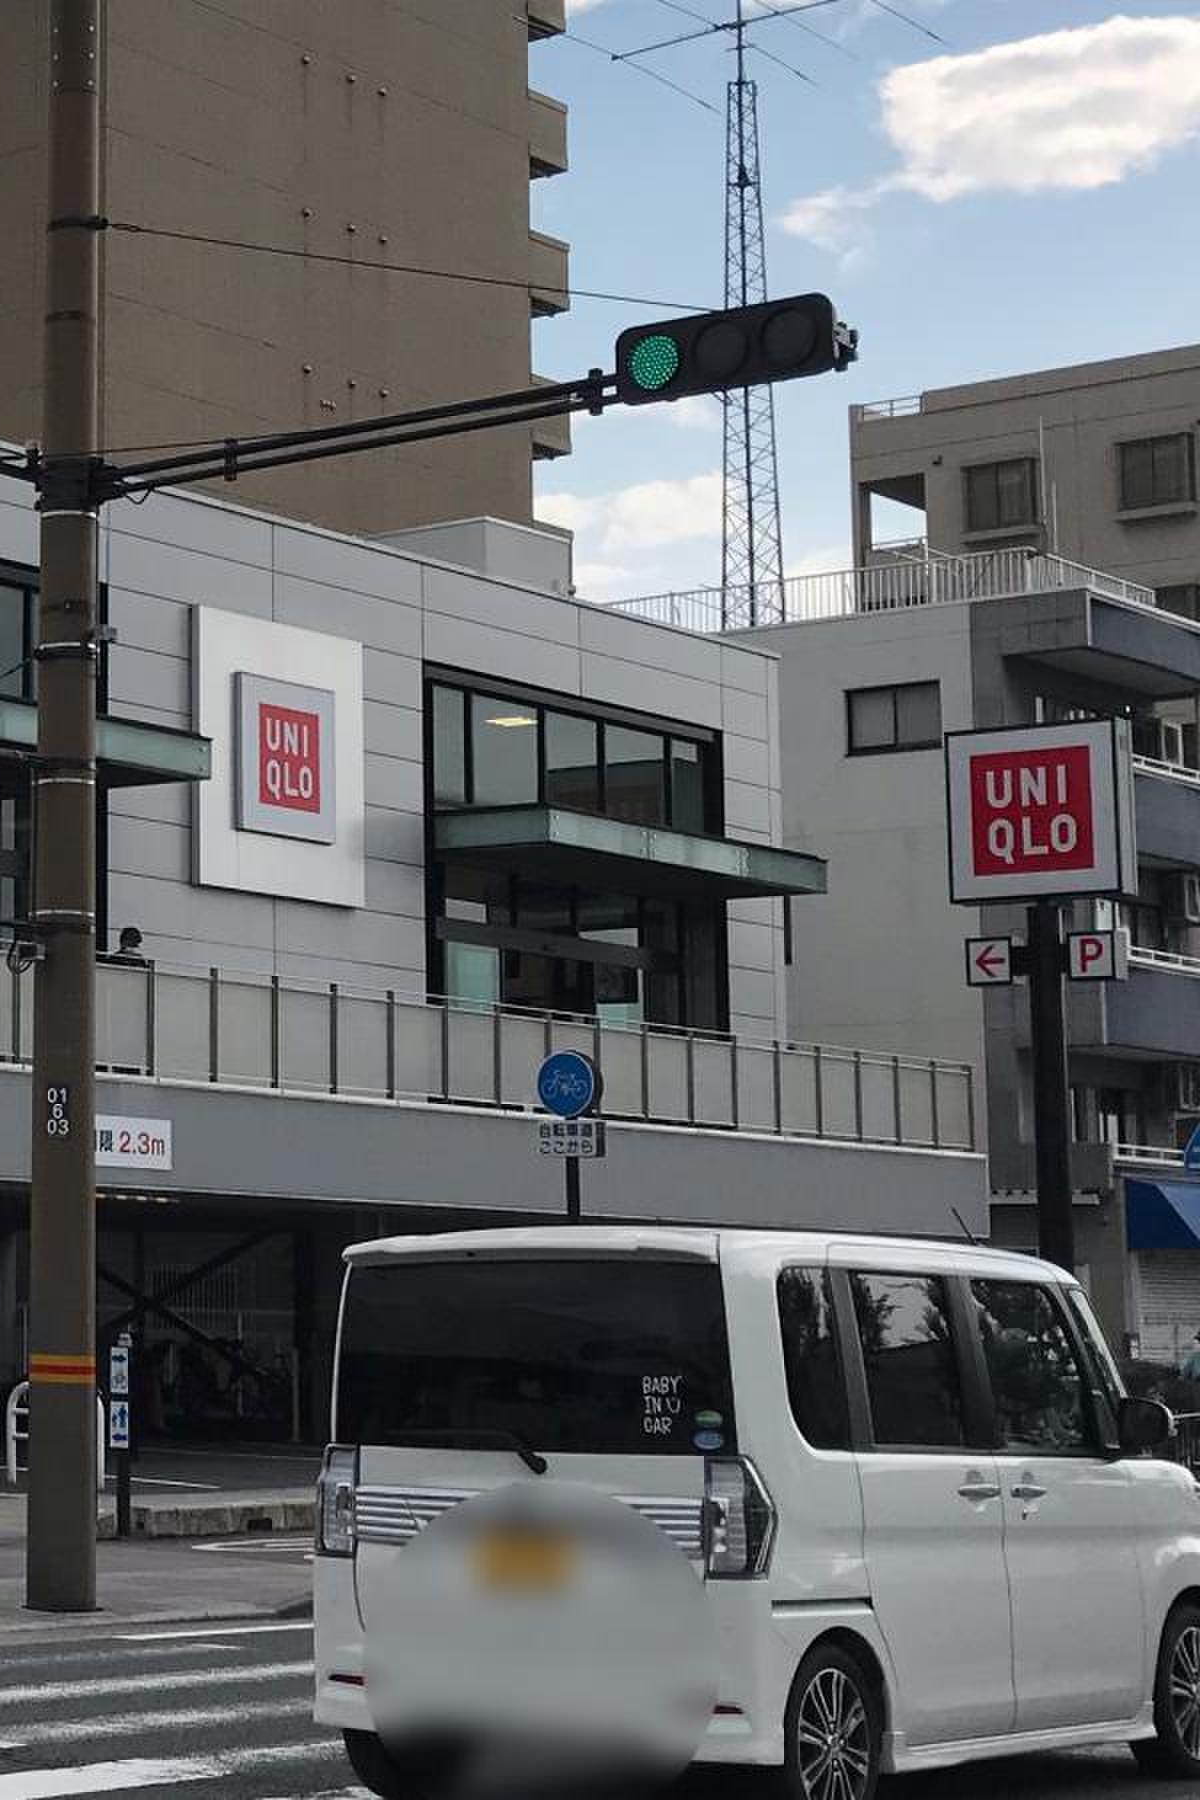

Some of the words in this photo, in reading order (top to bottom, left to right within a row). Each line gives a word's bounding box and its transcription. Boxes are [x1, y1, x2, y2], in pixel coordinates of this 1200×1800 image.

[265, 717, 309, 758] UNI
[266, 759, 313, 801] QLO
[985, 764, 1068, 809] UNI
[987, 813, 1078, 865] QLO
[1078, 937, 1104, 974] P
[47, 1087, 67, 1104] 01
[52, 1103, 64, 1119] 6
[47, 1119, 69, 1135] 03
[118, 1130, 165, 1156] 2.3m
[539, 1139, 593, 1154] ここから
[642, 1375, 682, 1394] BABY
[643, 1395, 662, 1414] IN
[643, 1416, 672, 1434] CAR
